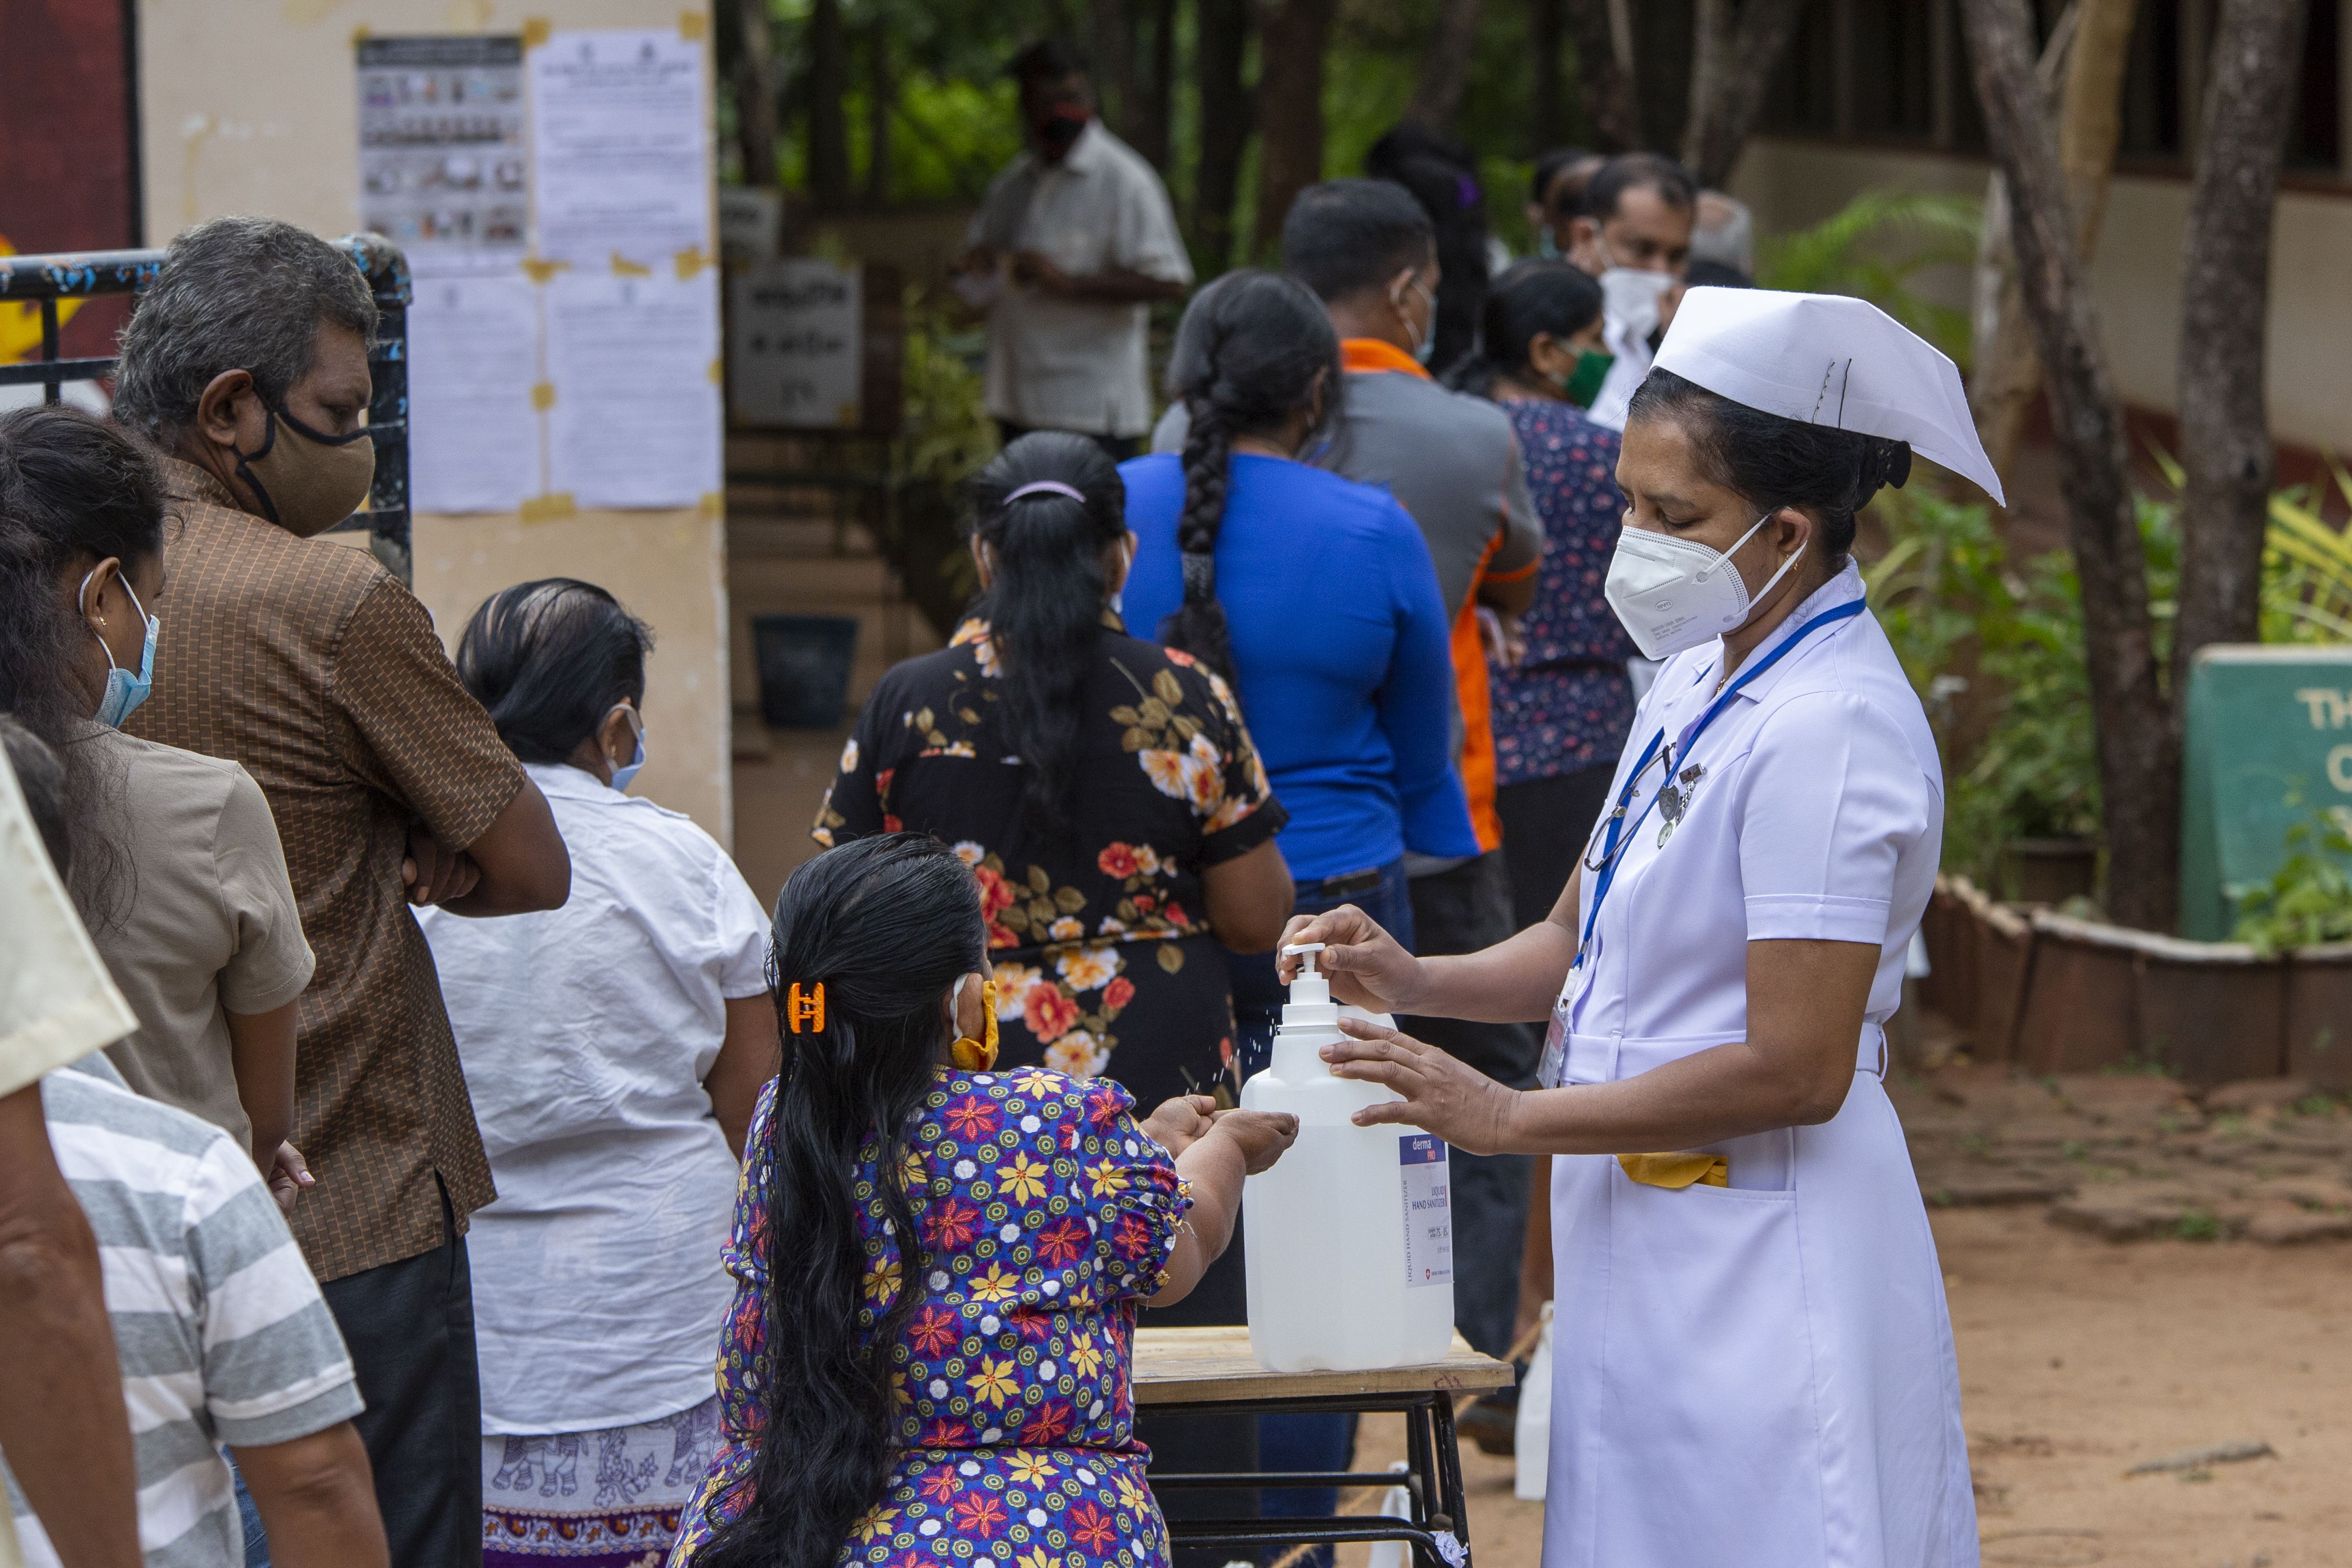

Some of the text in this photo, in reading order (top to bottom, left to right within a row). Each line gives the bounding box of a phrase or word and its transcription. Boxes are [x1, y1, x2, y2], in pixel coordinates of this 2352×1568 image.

[1412, 1137, 1431, 1150] derma
[1427, 1151, 1435, 1161] PRO
[1432, 1186, 1445, 1197] LIQUID
[1412, 1198, 1445, 1210] HAND SANITIZER
